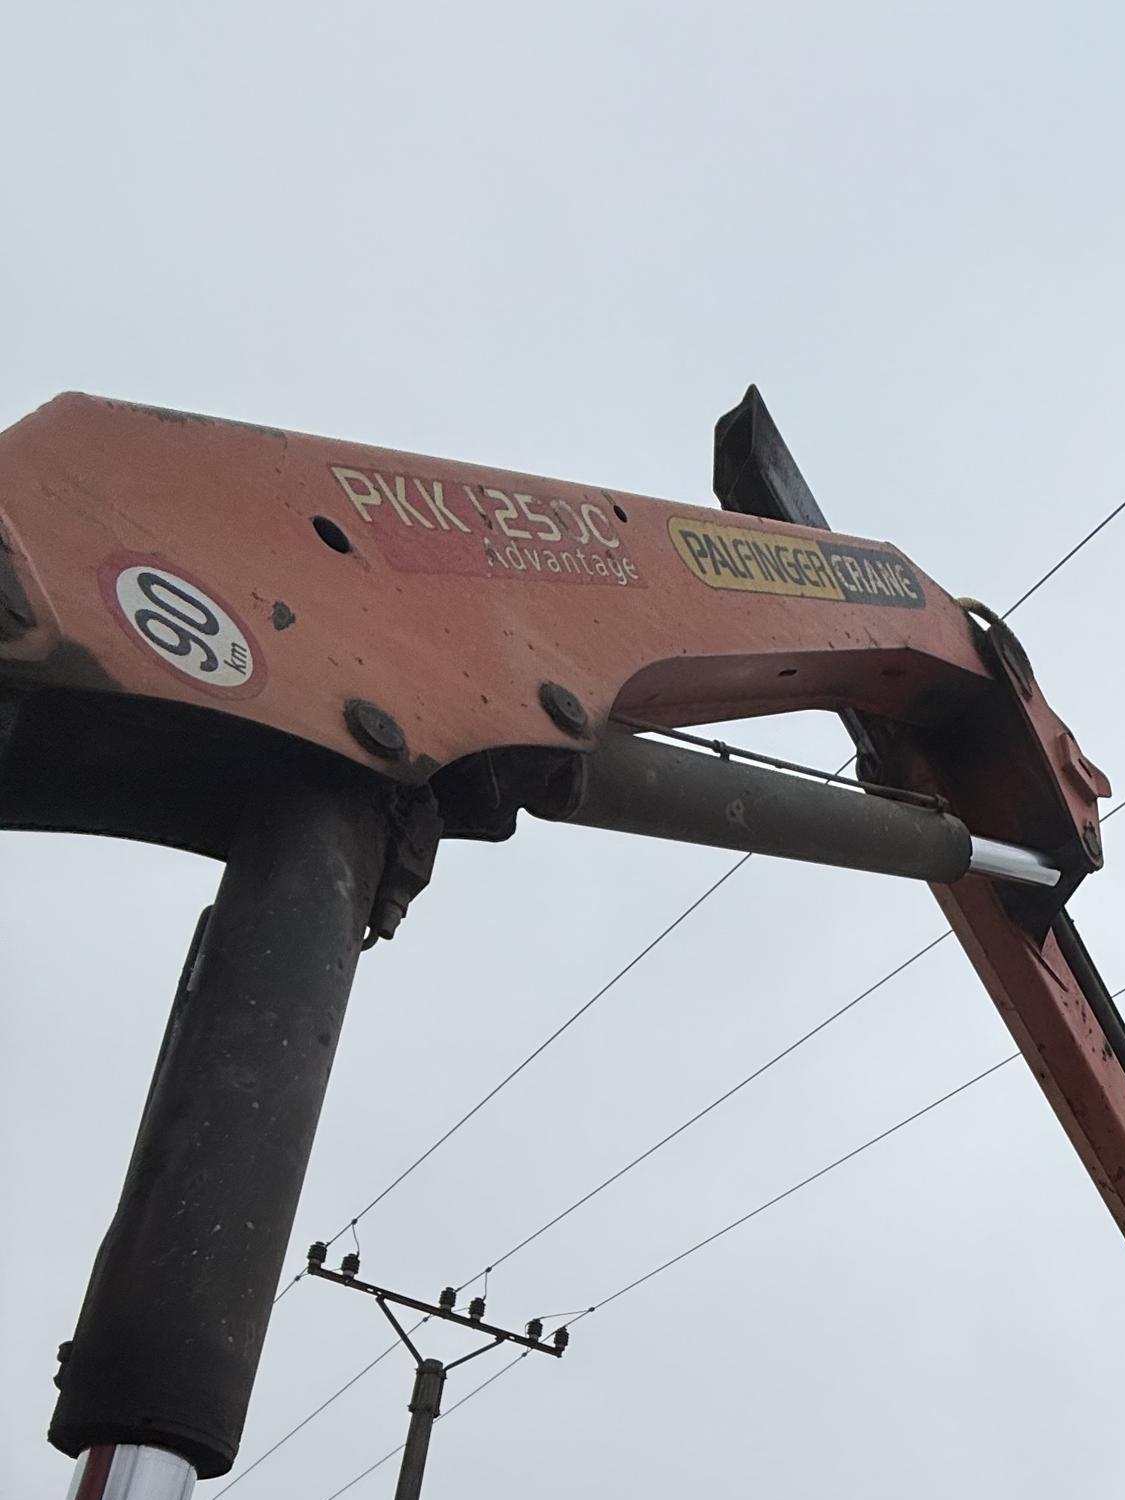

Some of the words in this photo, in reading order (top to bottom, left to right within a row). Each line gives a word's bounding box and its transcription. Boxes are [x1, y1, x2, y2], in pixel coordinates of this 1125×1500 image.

[331, 466, 472, 533] PKK
[484, 536, 639, 586] Advantage
[679, 529, 837, 589] PALFINGER
[830, 554, 918, 599] CRANE
[134, 567, 220, 673] 90
[223, 642, 248, 676] km
